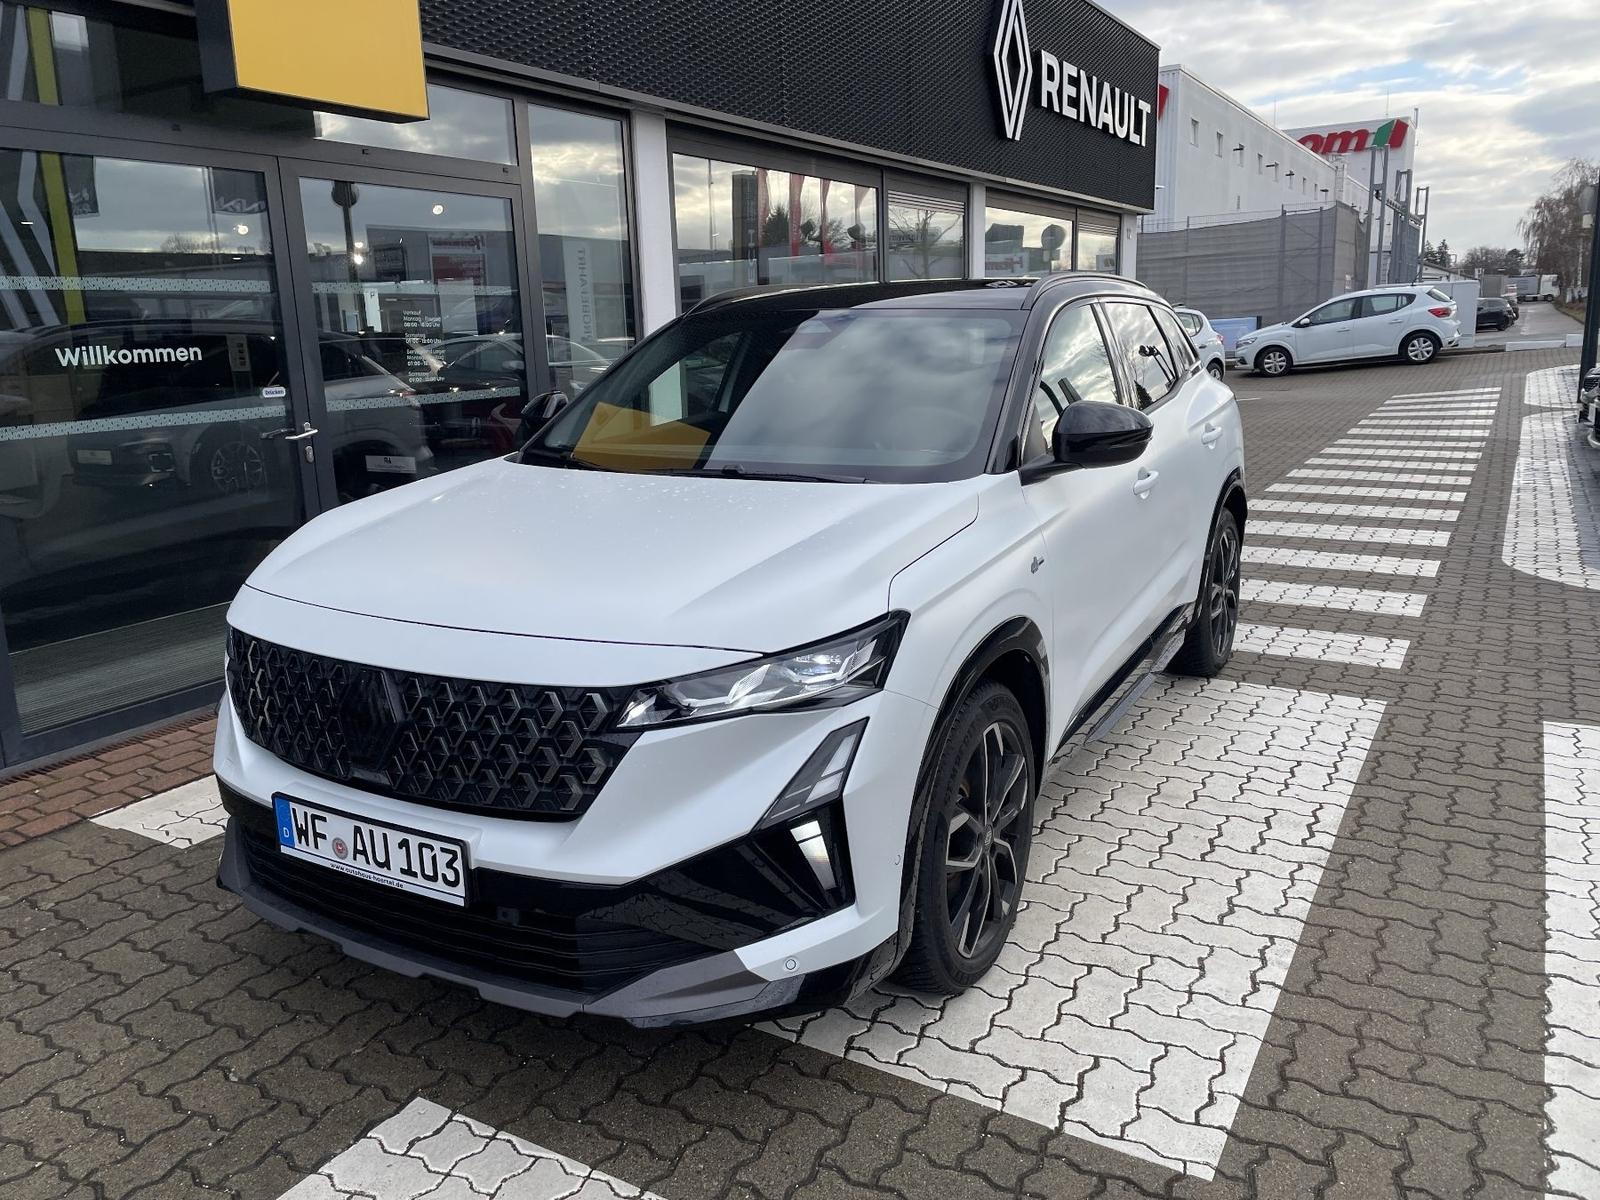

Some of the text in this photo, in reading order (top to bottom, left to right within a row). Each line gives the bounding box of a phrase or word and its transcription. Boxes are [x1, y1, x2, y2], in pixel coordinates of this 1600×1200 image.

[1041, 49, 1151, 147] RENAULT
[55, 345, 202, 367] Willkommen
[283, 808, 460, 888] D WF AU 103
